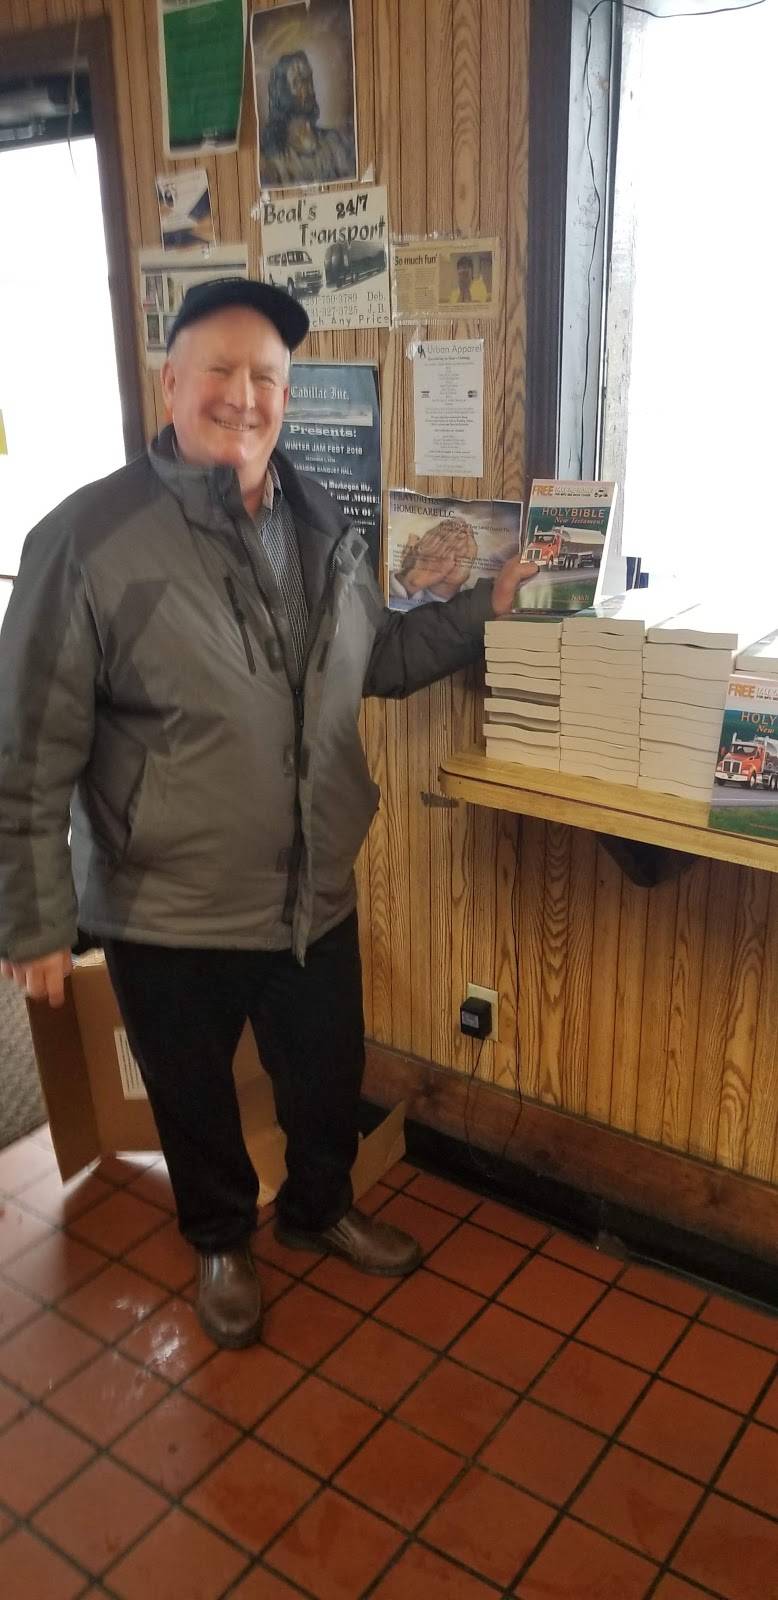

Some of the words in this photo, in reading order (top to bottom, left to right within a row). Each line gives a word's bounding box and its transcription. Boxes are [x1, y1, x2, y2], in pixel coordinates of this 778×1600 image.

[263, 199, 317, 226] Beal's
[335, 193, 368, 219] 24/7
[300, 216, 386, 247] Transport
[394, 254, 403, 265] So
[404, 253, 423, 265] much
[331, 316, 352, 327] Any
[359, 312, 389, 325] Price
[427, 344, 449, 354] Urban
[452, 342, 482, 355] Apparel
[290, 385, 327, 399] Cadillac
[289, 424, 357, 438] Presents:
[285, 440, 310, 452] WINTER
[311, 442, 326, 452] JAM
[328, 444, 344, 454] FEST
[533, 485, 554, 497] FREE
[393, 502, 416, 514] HOME
[417, 505, 439, 517] CARE
[728, 683, 755, 698] FREE
[741, 711, 777, 726] HOLY
[757, 724, 775, 735] New
